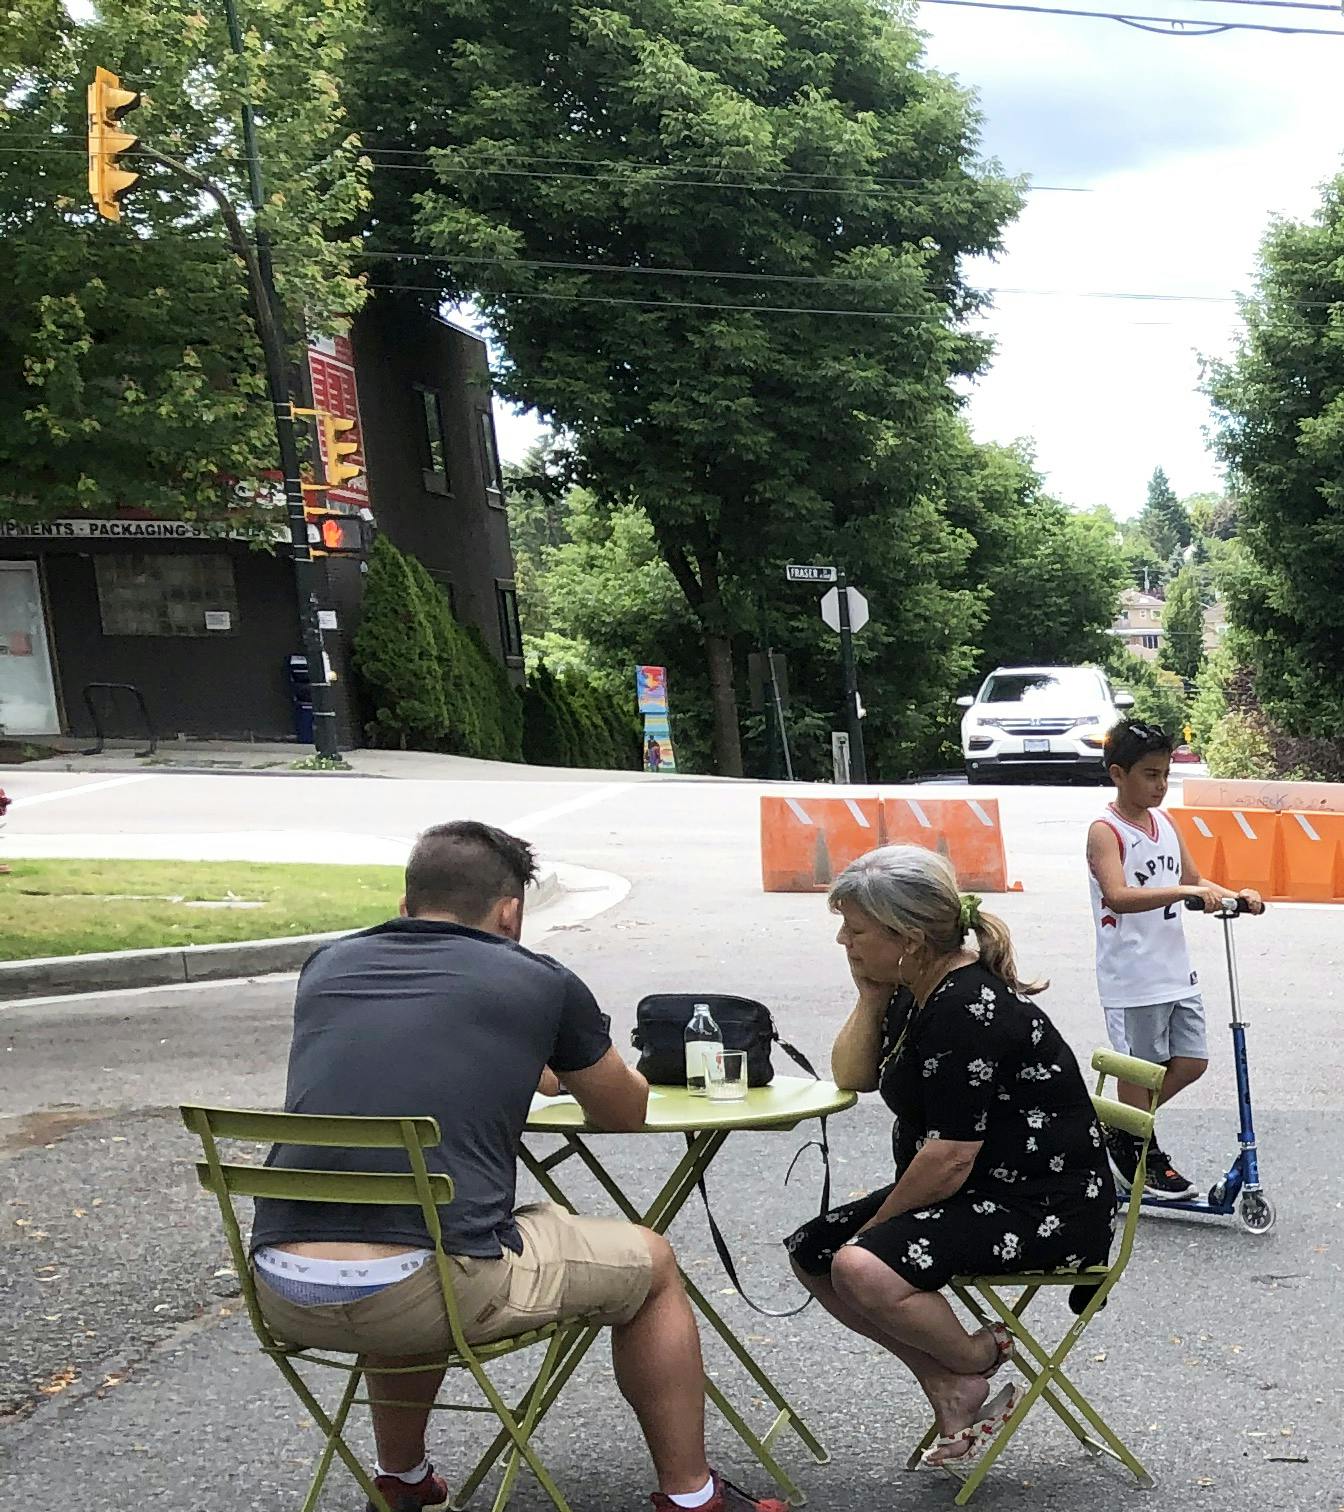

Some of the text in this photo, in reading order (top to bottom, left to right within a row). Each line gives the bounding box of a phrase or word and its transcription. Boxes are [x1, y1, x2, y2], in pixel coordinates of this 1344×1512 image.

[89, 523, 186, 537] PACKAGING
[790, 567, 818, 579] FRASER
[1134, 855, 1180, 887] APTO
